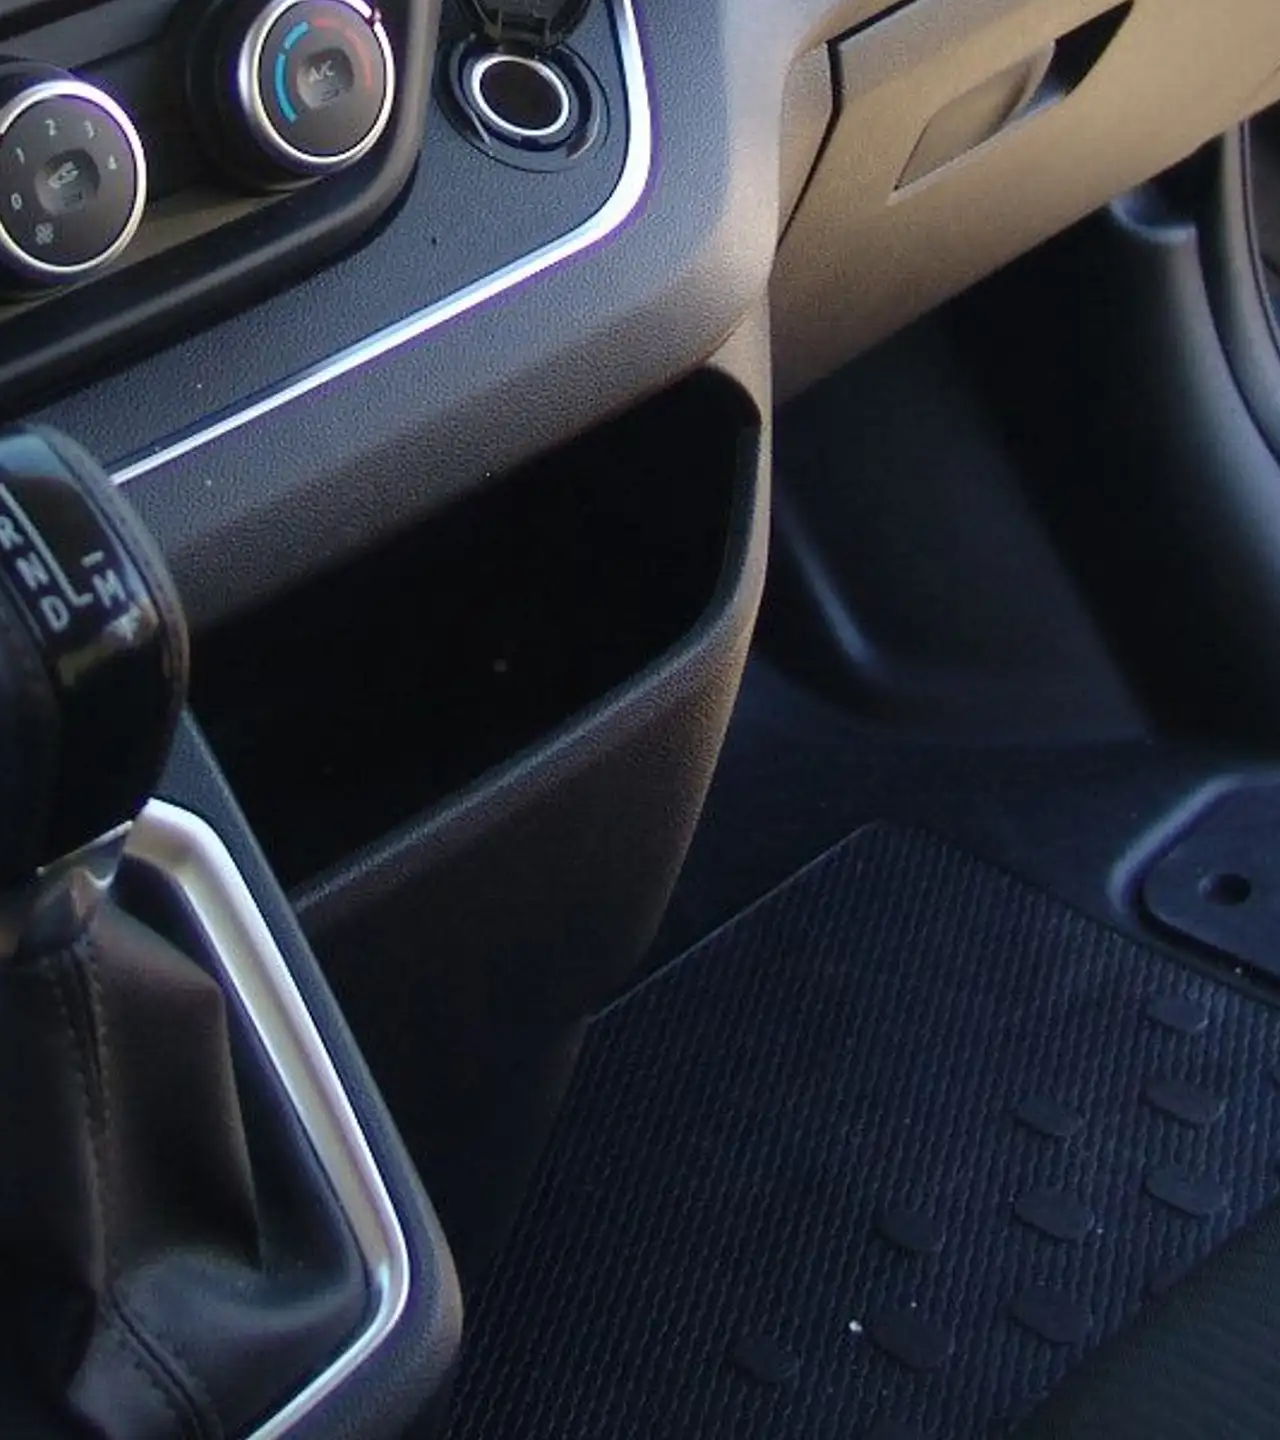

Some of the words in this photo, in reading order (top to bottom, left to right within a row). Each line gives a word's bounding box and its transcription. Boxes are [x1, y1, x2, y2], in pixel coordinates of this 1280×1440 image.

[15, 551, 50, 591] N
[38, 595, 71, 633] D
[91, 567, 128, 609] M
